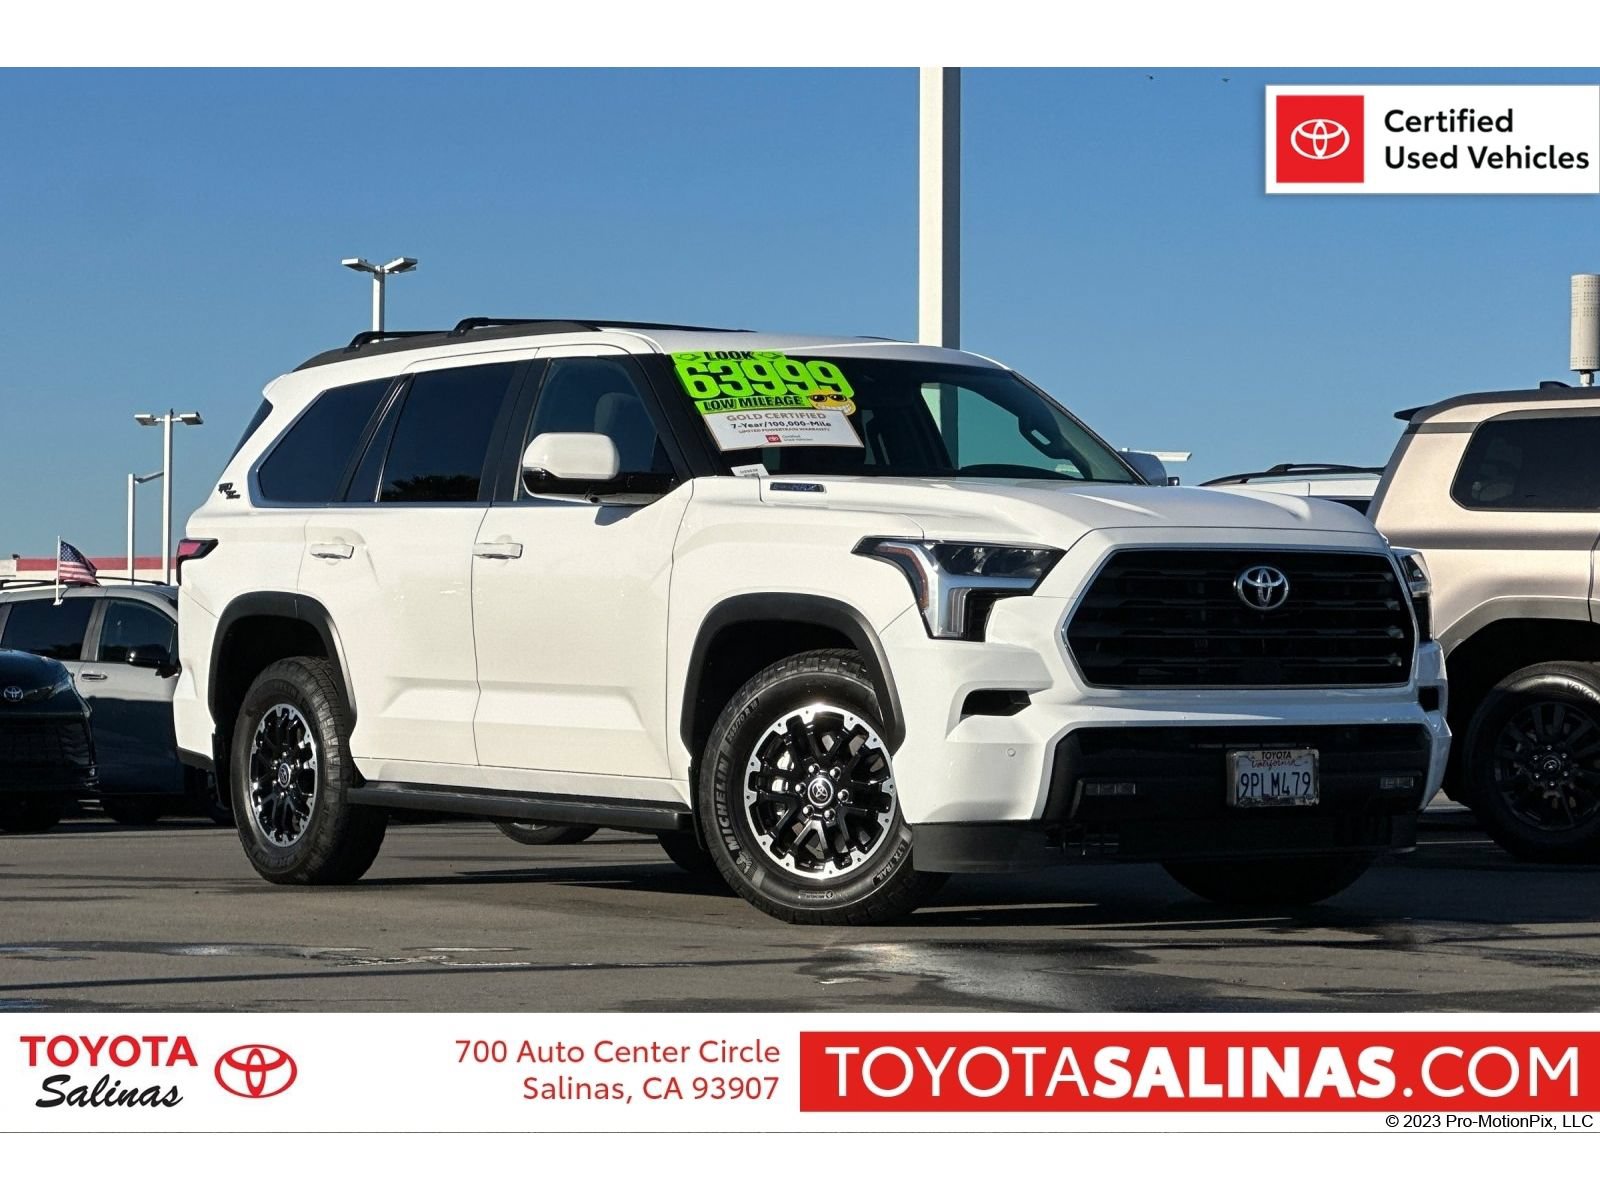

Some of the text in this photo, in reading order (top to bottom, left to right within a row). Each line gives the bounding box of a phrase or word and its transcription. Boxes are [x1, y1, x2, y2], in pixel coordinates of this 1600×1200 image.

[703, 350, 757, 361] LOOK
[675, 359, 855, 399] 63999
[703, 396, 804, 411] LOW MILEAGE
[726, 411, 828, 421] GOLD CERTIFIED
[1261, 751, 1293, 760] TOYOTA
[1239, 771, 1312, 798] 9PLM479
[716, 756, 741, 852] MICHELIN
